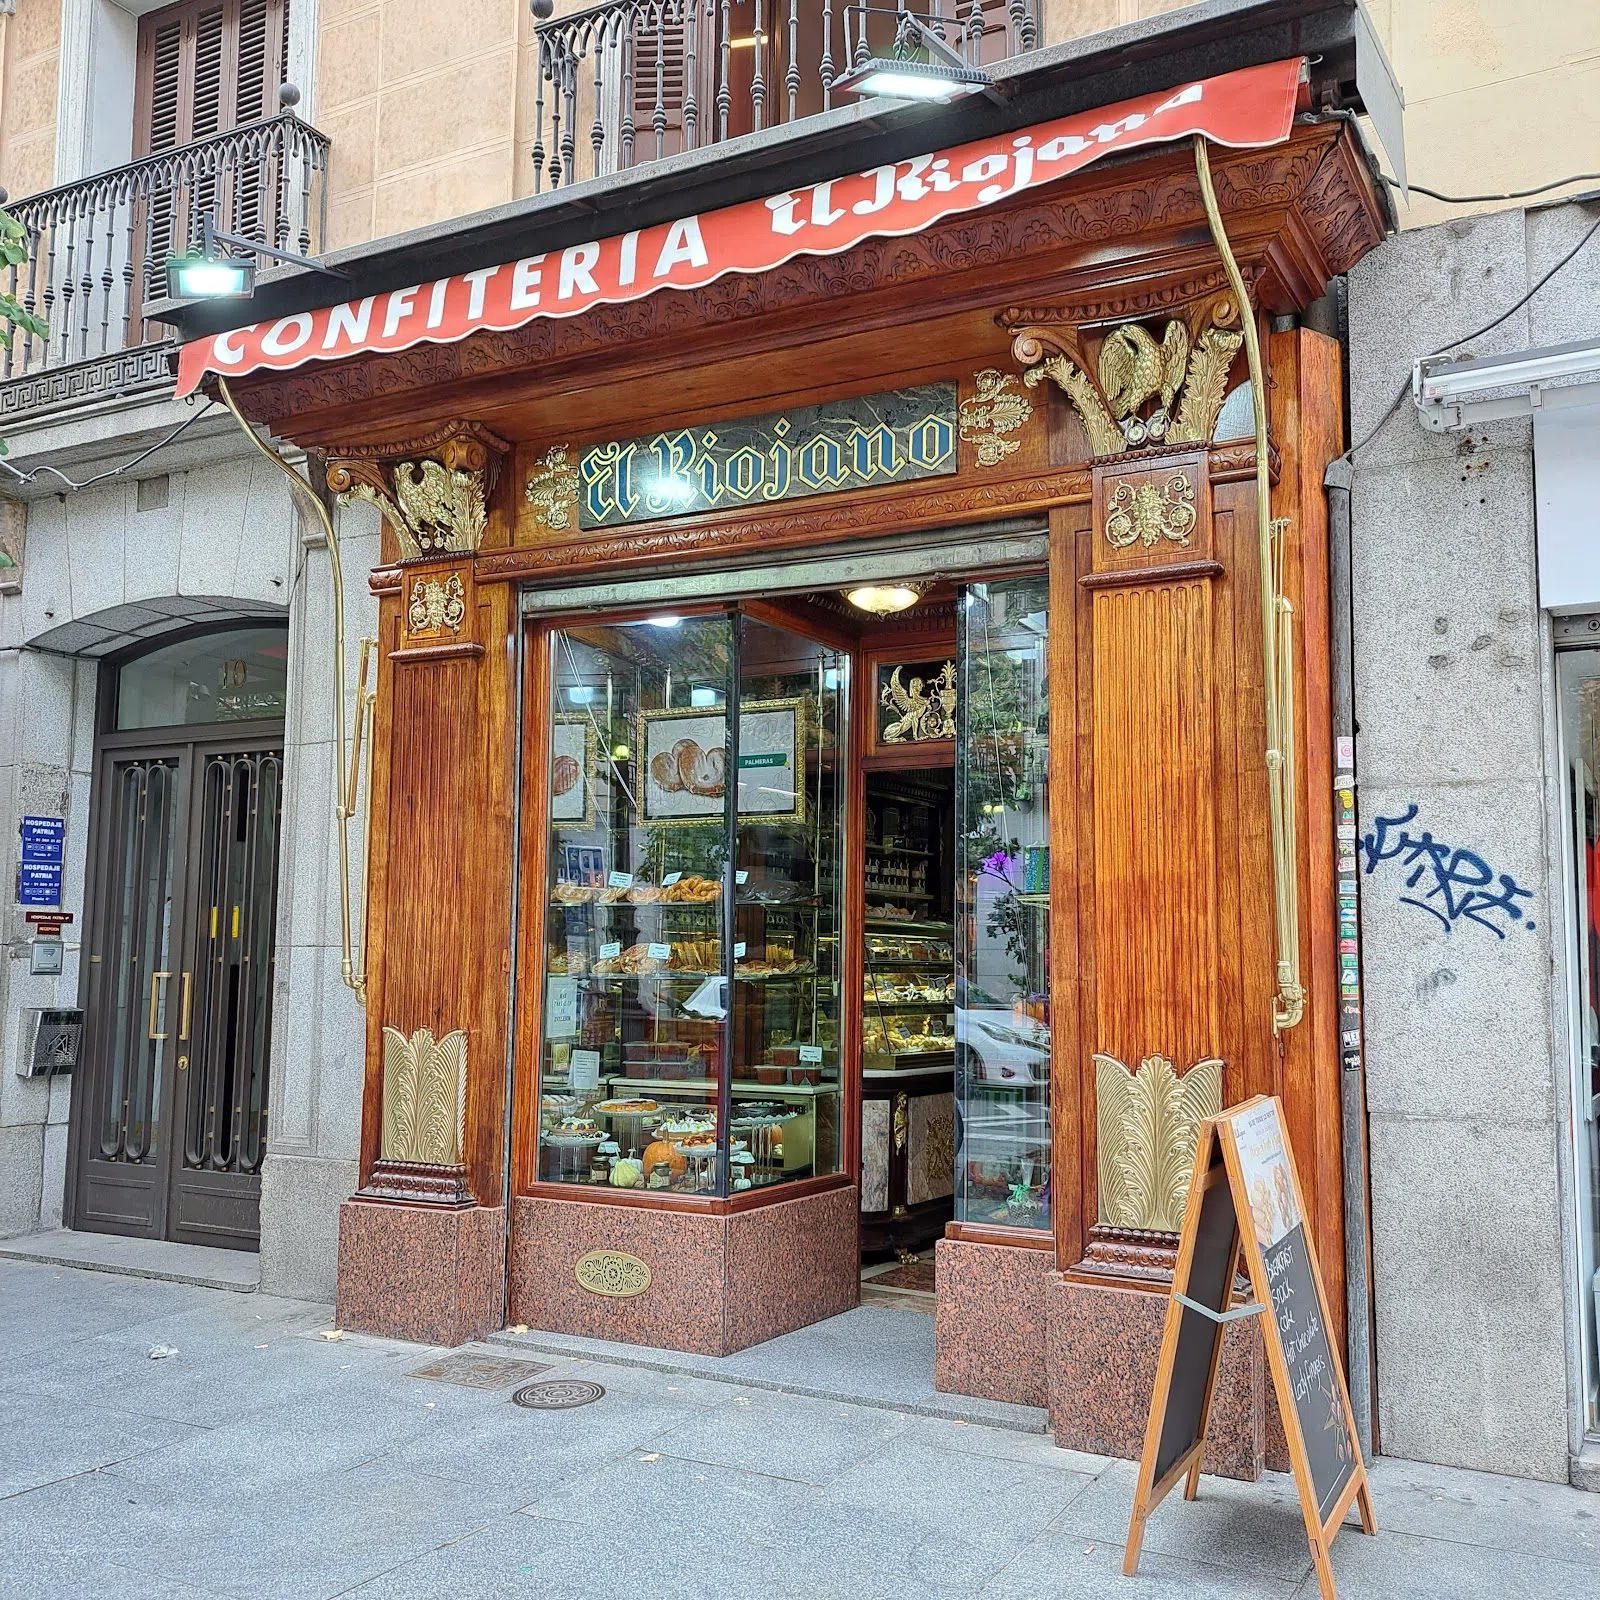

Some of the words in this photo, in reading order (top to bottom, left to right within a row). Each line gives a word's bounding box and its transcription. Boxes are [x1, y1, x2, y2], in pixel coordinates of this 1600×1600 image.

[213, 216, 709, 364] CONFITERIA
[580, 441, 641, 522] El
[645, 413, 954, 514] Riojano
[744, 758, 774, 766] PALMERAS
[25, 819, 62, 828] HOSPEDAJE
[32, 828, 55, 836] PATRIA
[23, 864, 60, 872] HOSPEDAJE
